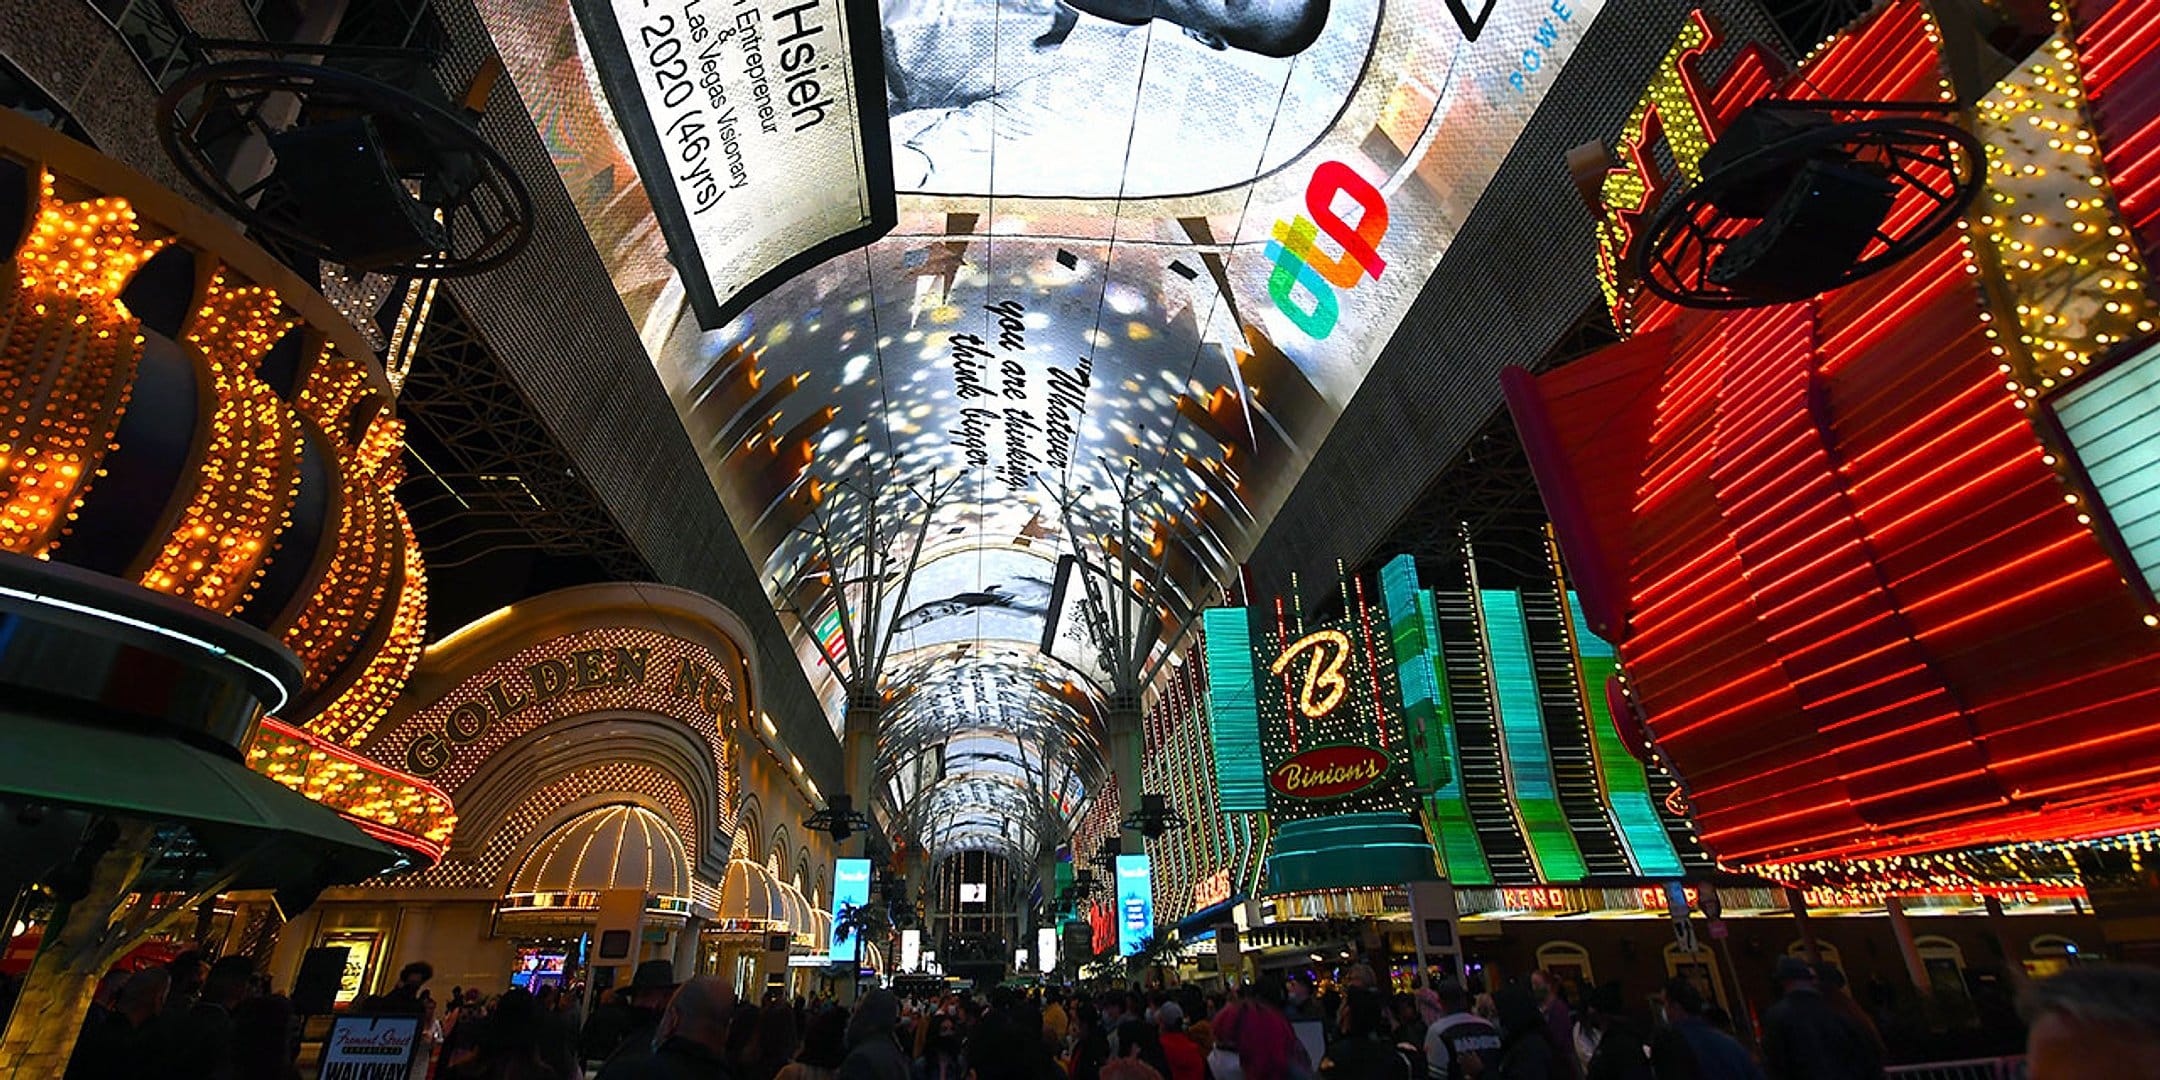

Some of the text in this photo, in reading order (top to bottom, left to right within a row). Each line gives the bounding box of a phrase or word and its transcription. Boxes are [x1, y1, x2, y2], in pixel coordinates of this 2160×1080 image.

[640, 15, 694, 108] 2020
[718, 27, 737, 44] &
[736, 8, 778, 134] Entrepreneur
[772, 1, 834, 132] Hsieh
[1509, 0, 1574, 93] POWE
[684, 0, 749, 189] Las Vegas Visionary
[948, 333, 997, 399] think
[984, 300, 1026, 351] you
[1000, 359, 1027, 400] are
[405, 648, 650, 777] GOLDEN
[1271, 630, 1350, 718] B
[1278, 758, 1380, 791] Binion's
[1503, 888, 1565, 909] KENO
